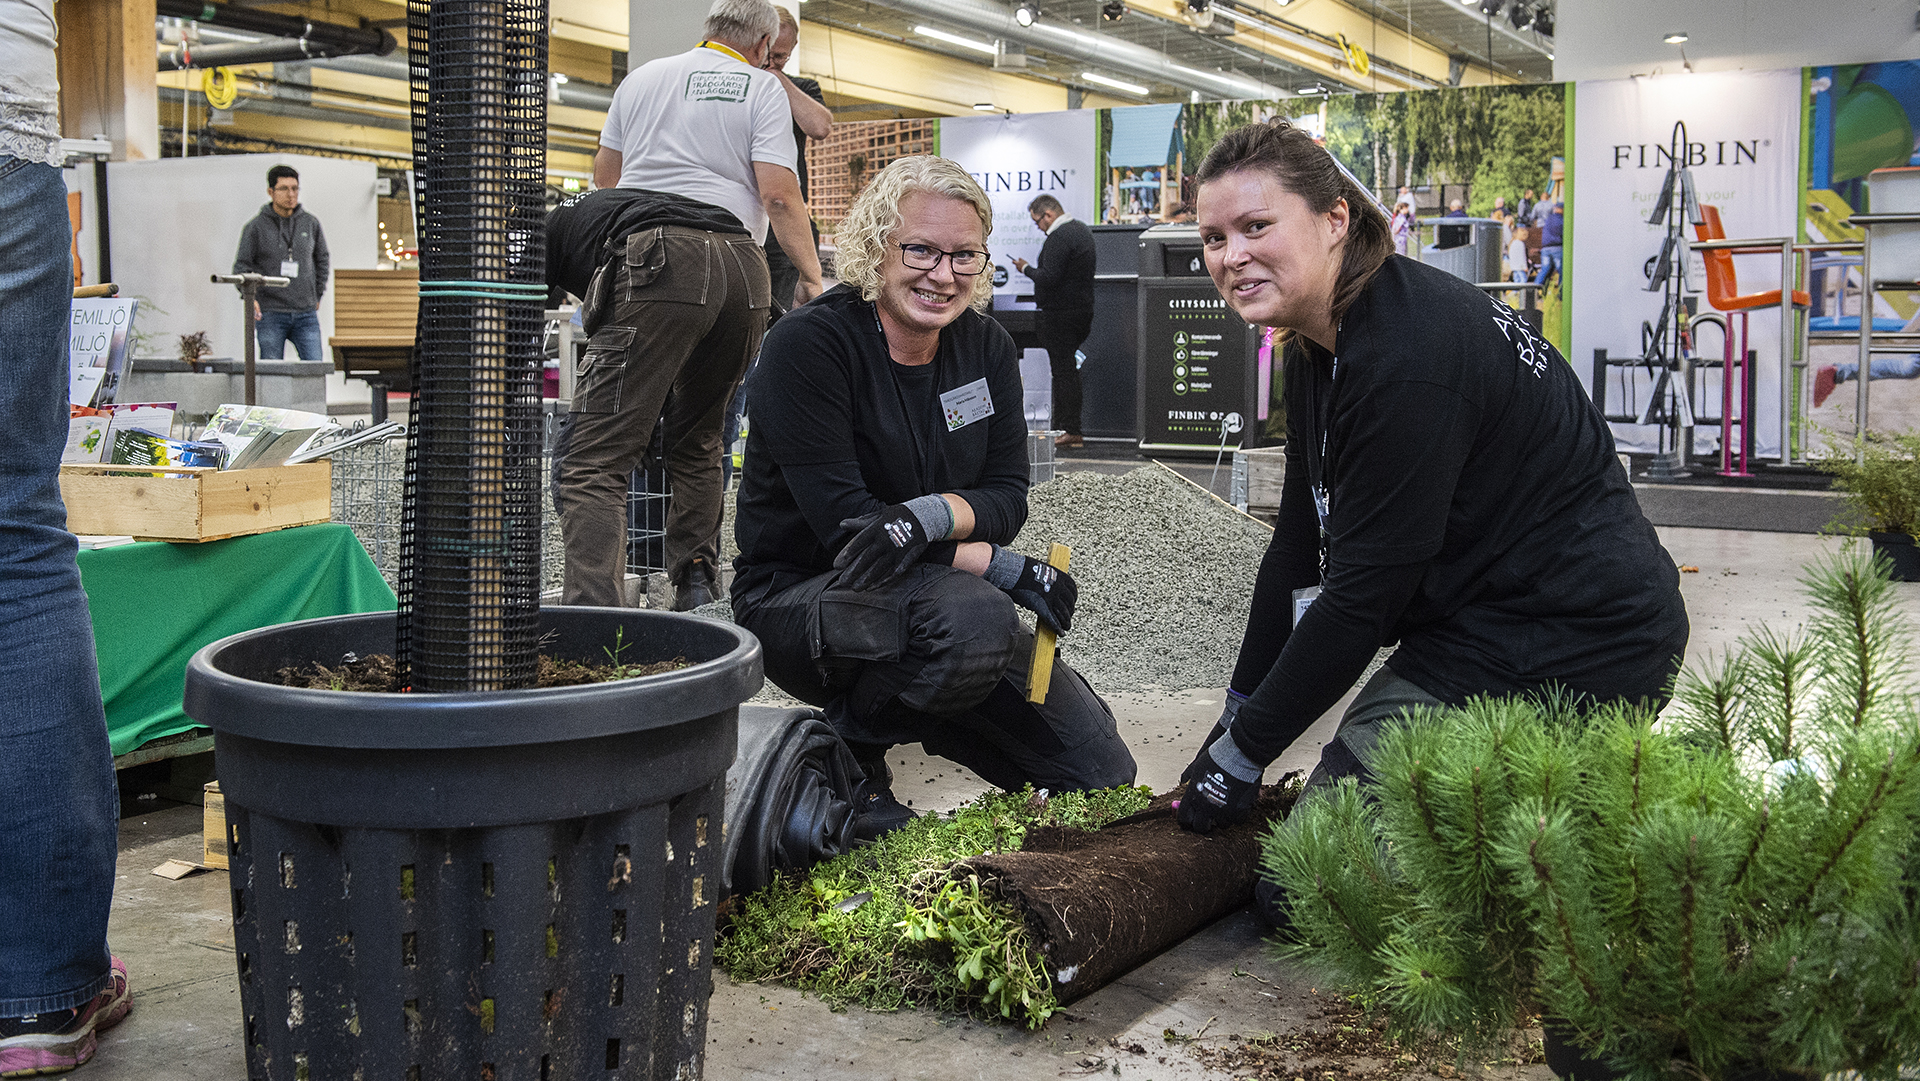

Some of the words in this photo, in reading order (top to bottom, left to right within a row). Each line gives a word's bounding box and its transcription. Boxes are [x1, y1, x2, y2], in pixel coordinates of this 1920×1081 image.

[1706, 190, 1736, 202] your
[1011, 225, 1032, 233] over
[1169, 299, 1226, 309] CITYSOLAR
